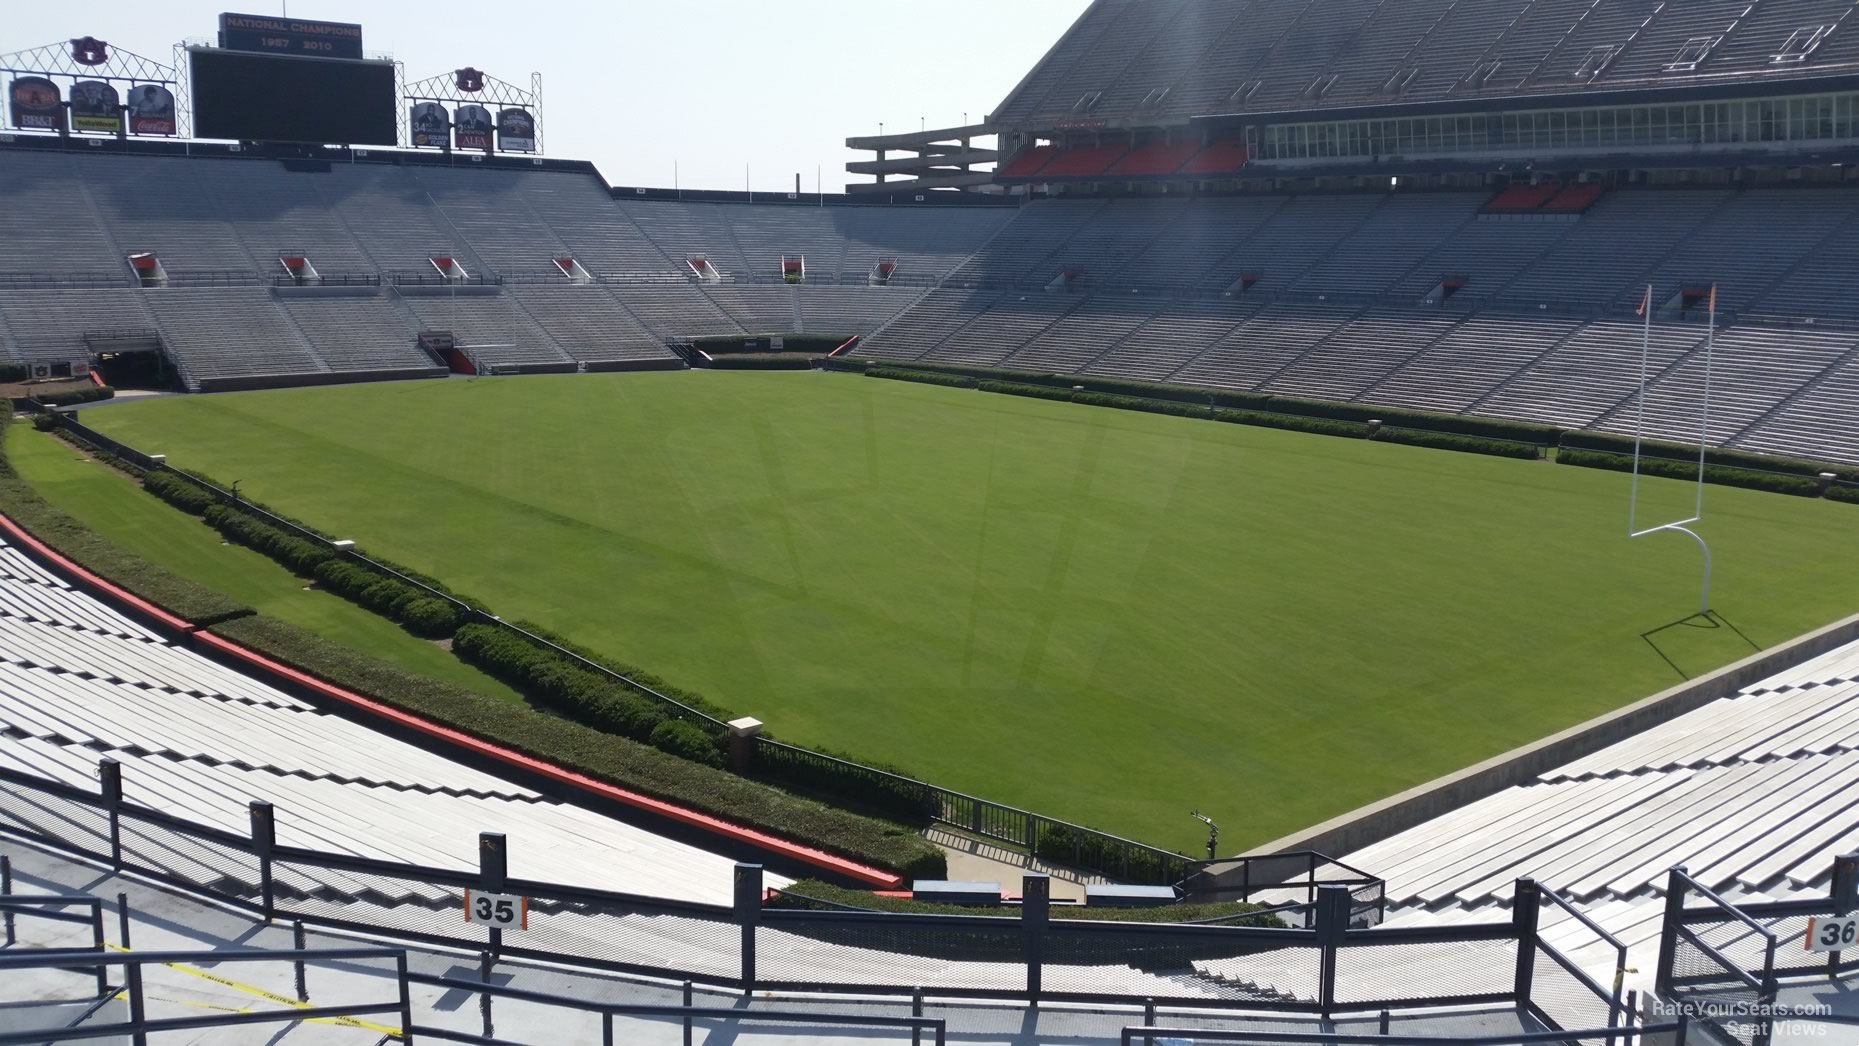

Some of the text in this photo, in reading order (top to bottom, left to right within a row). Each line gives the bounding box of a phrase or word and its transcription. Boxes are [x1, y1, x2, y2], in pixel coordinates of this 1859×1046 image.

[227, 17, 360, 36] NATIONAL CHAMPIONS
[303, 41, 332, 50] 2010
[22, 114, 53, 127] BB&T
[413, 121, 426, 133] 34
[457, 123, 464, 134] 2
[463, 135, 487, 146] ALFA
[476, 896, 514, 924] 35
[1820, 921, 1857, 946] 36
